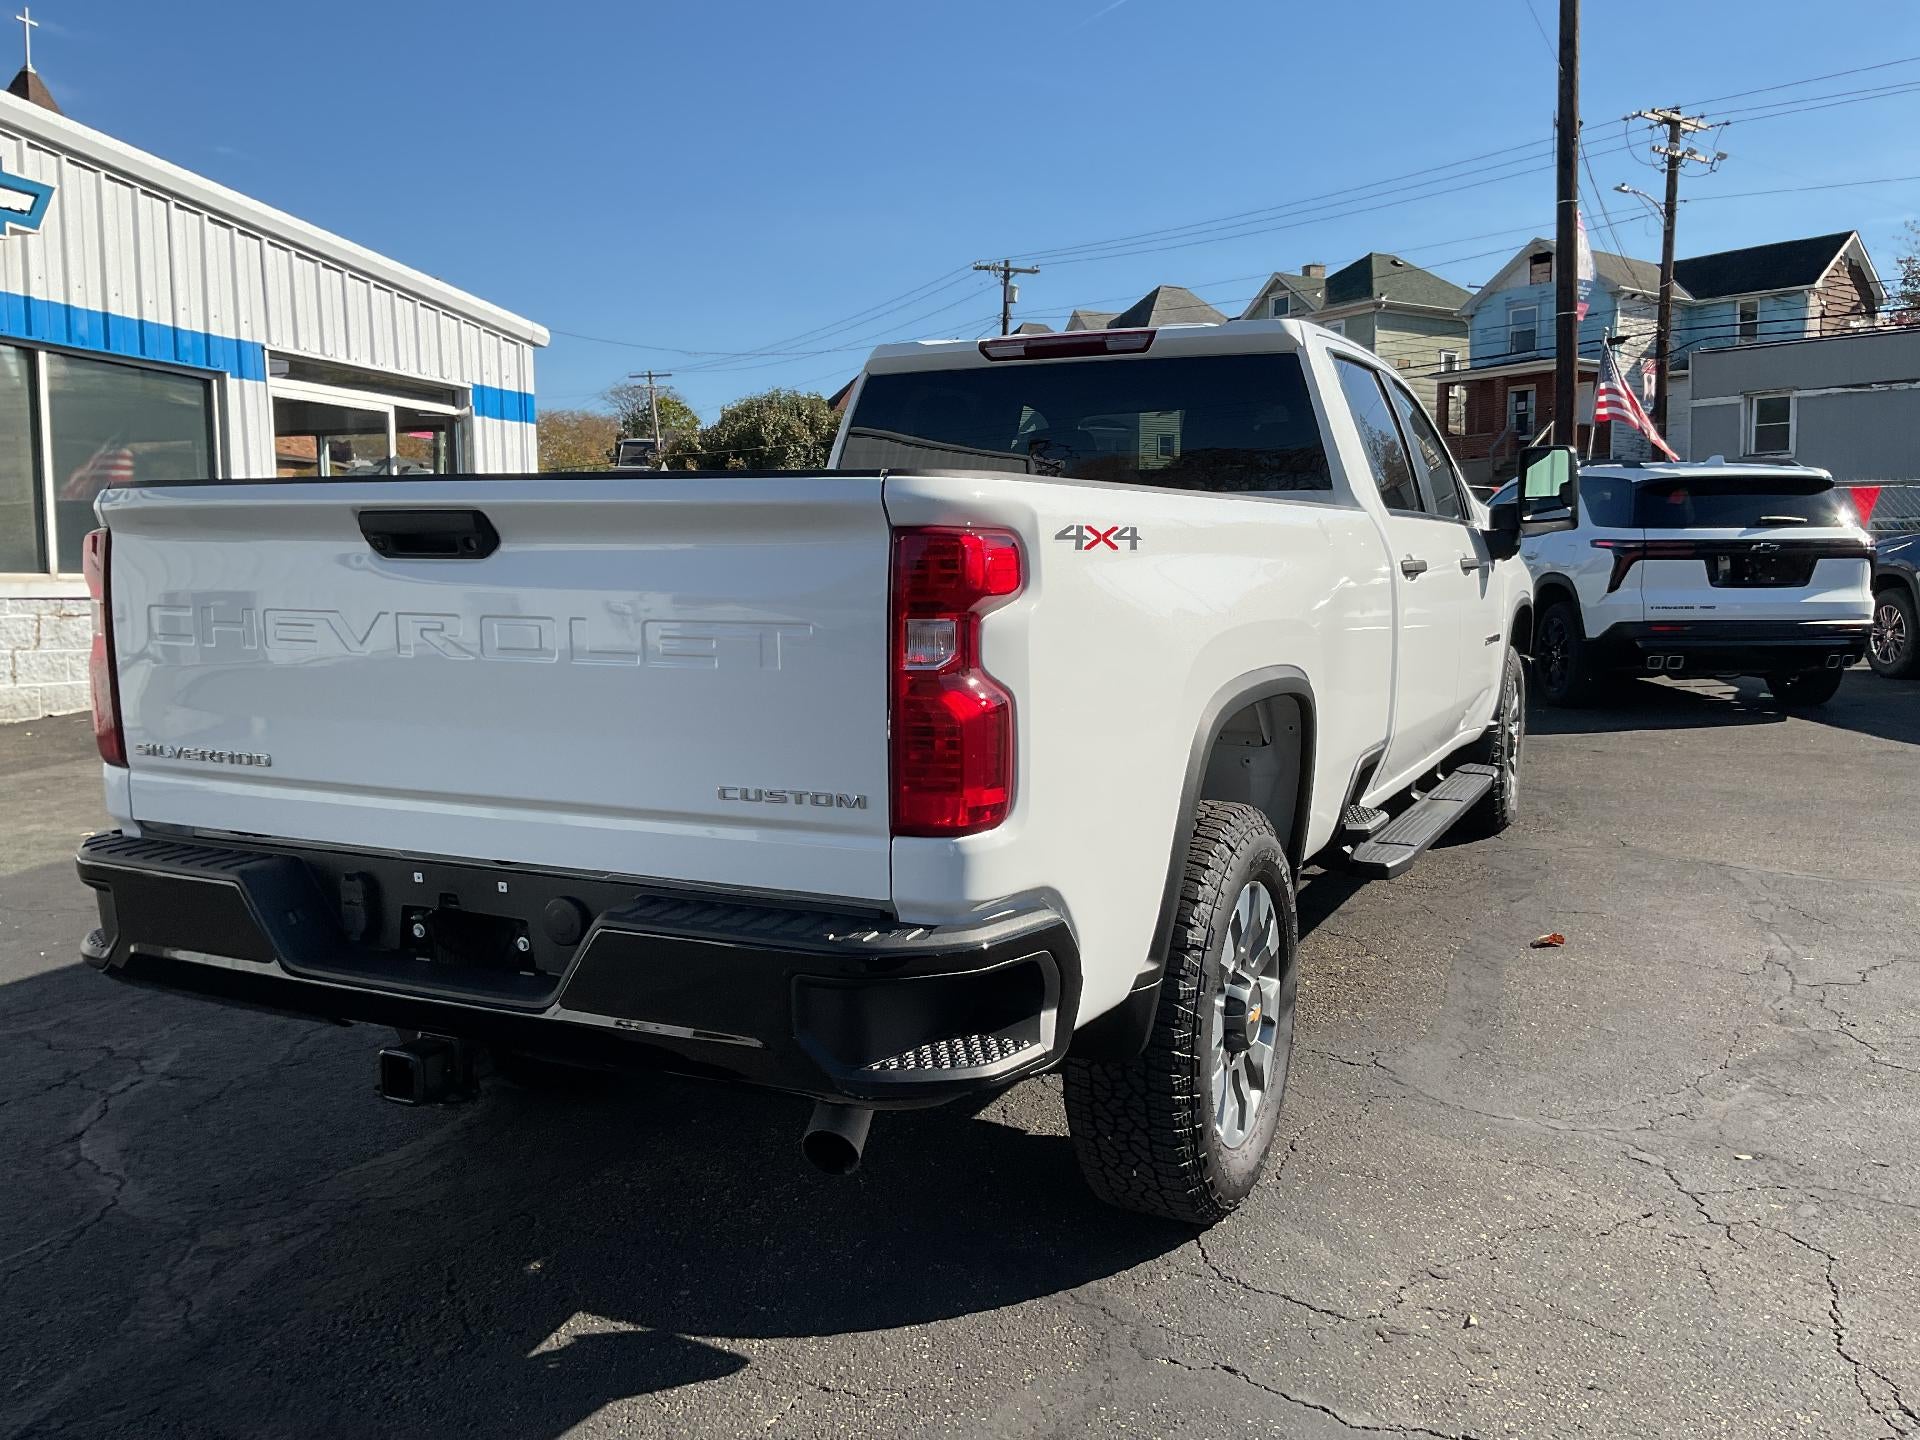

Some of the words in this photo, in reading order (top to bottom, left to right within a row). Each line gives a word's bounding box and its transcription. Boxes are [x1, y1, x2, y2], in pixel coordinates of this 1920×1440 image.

[147, 604, 814, 672] CHEVROLET
[135, 743, 273, 767] SILVERADO
[717, 785, 868, 810] CUSTOM
